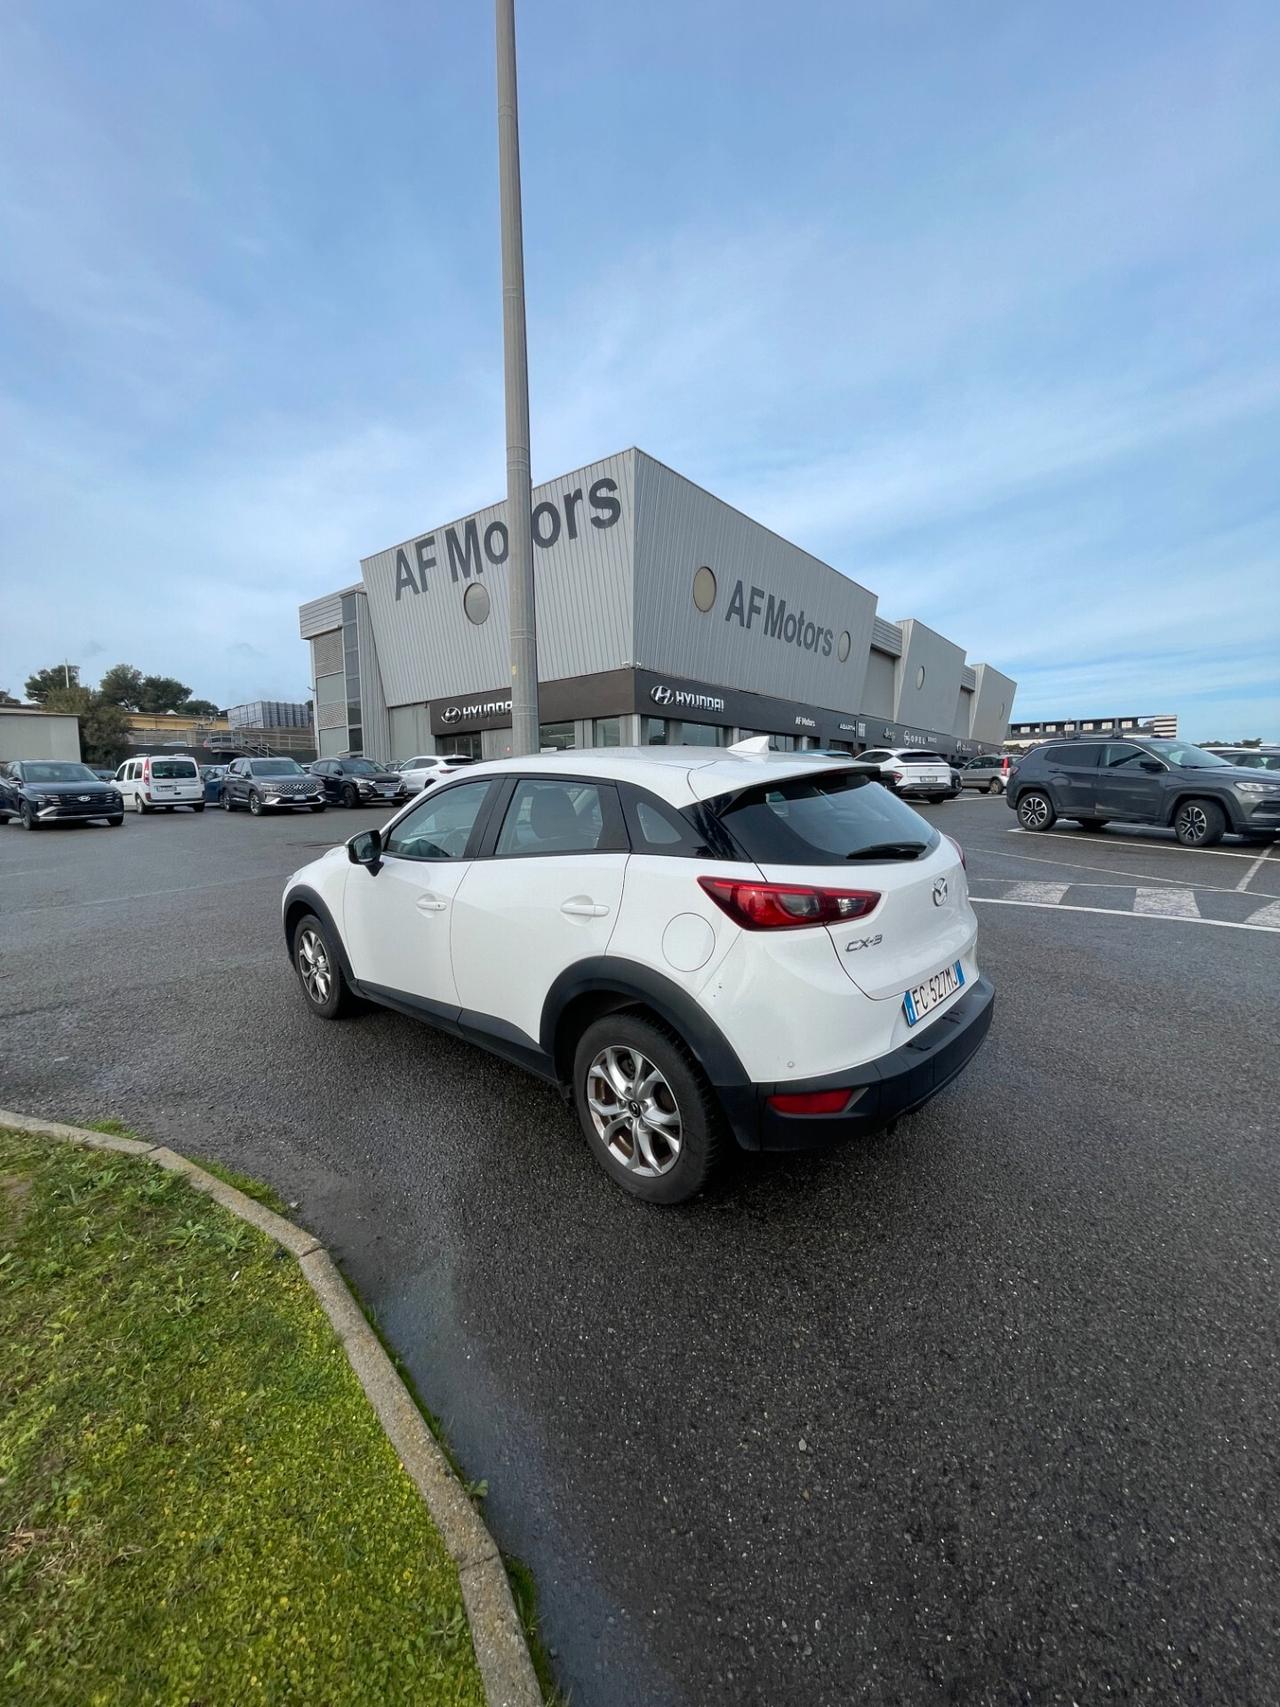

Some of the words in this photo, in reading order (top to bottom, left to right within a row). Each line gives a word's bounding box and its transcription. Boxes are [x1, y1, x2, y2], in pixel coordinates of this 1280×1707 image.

[395, 535, 437, 601] AF
[445, 477, 621, 583] Moors
[725, 579, 765, 629] AF
[763, 593, 834, 657] Motors
[463, 701, 513, 719] HYUNDA
[676, 690, 725, 711] HYUNDAI
[845, 934, 883, 952] CX-3
